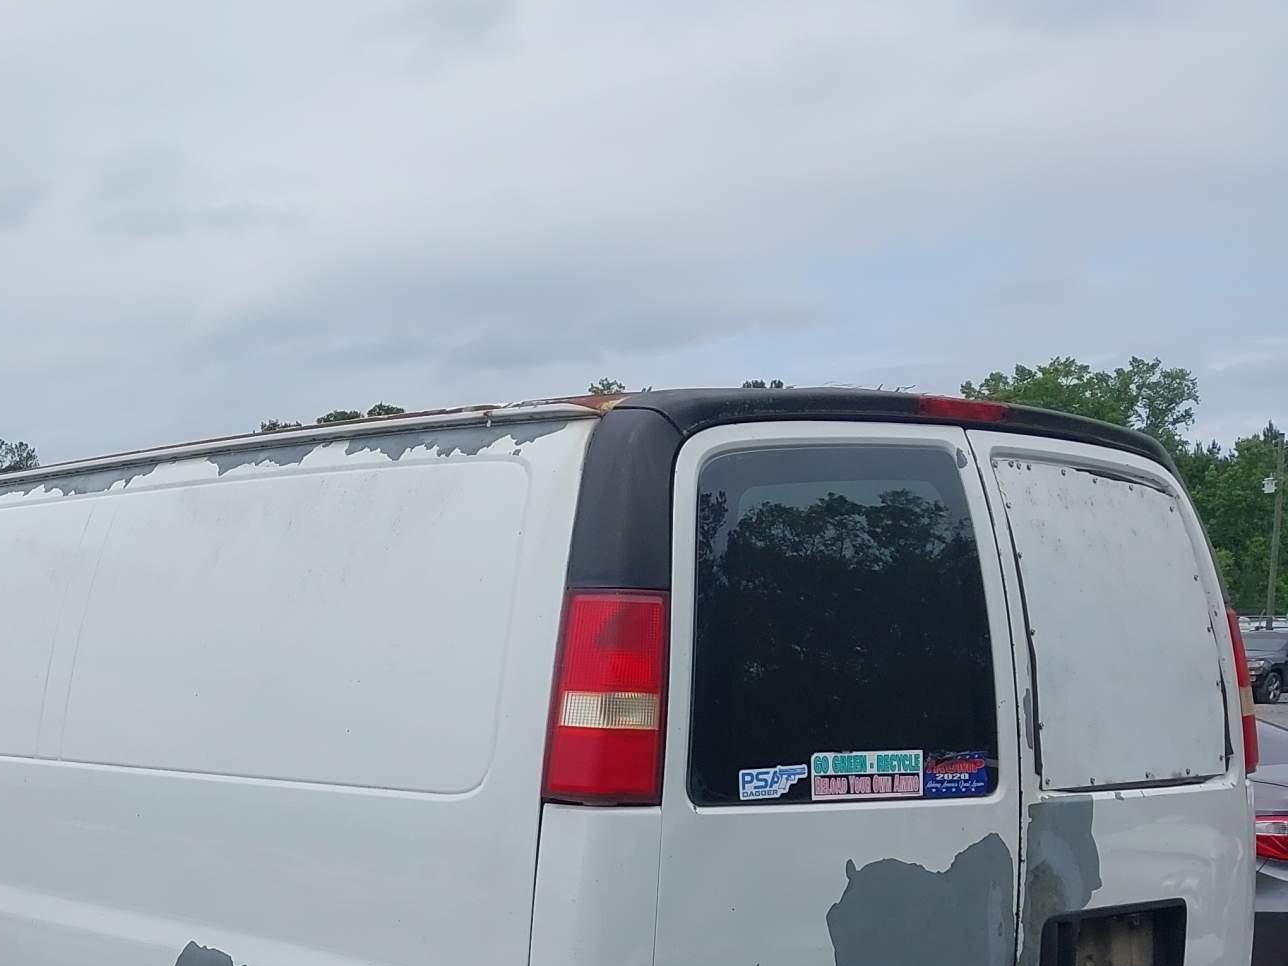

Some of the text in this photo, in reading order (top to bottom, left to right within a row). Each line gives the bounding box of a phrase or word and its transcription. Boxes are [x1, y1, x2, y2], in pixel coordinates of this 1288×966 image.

[814, 755, 830, 774] GO
[832, 754, 868, 773] GREEN
[876, 753, 920, 772] RECYCLE
[935, 773, 969, 781] 2020
[742, 789, 779, 798] DAGGER
